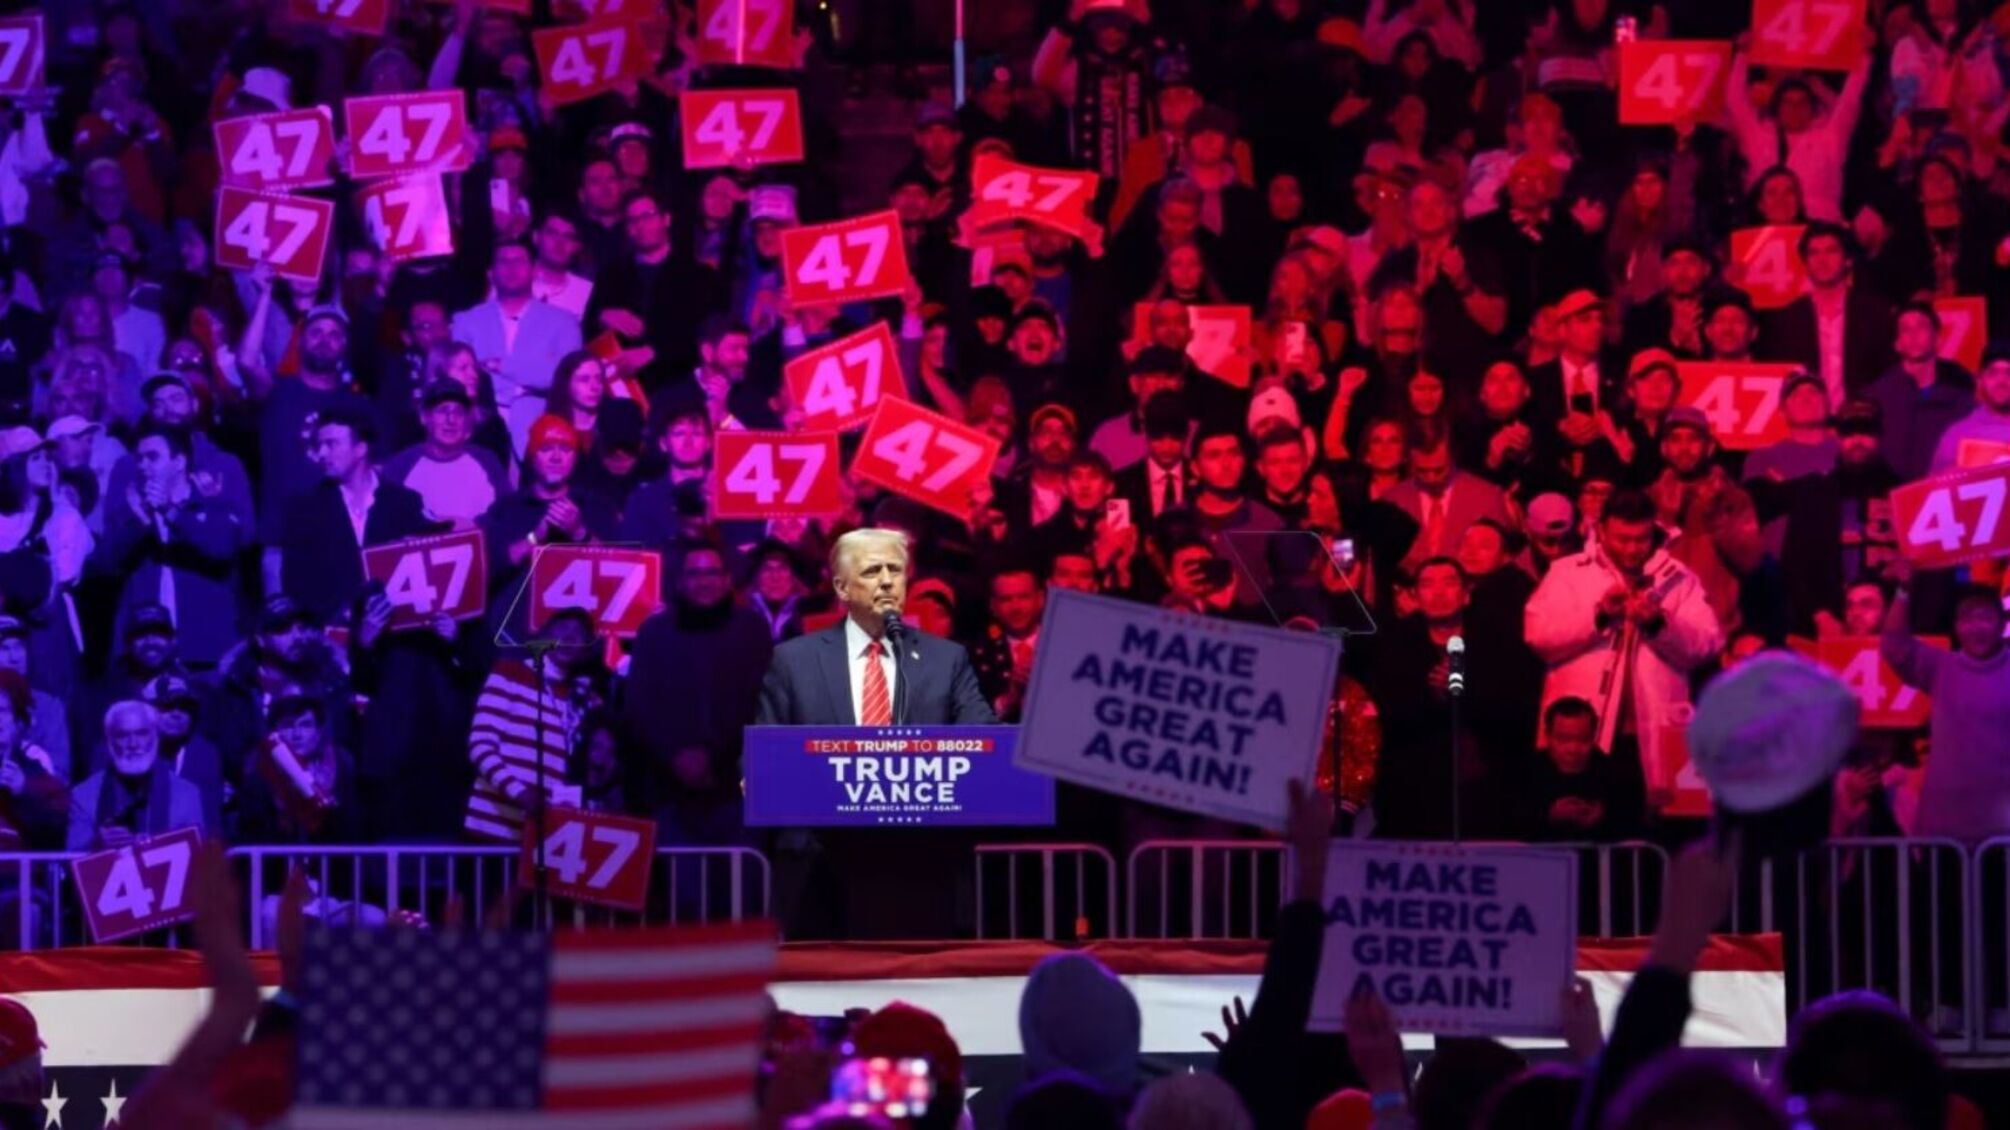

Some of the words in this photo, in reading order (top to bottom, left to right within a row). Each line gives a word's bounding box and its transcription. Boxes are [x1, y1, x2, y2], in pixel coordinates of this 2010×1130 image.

[0, 28, 30, 80] 7
[551, 27, 626, 86] 47
[1761, 3, 1851, 55] 47
[1634, 53, 1724, 108] 47
[230, 119, 320, 181] 47
[360, 102, 452, 163] 47
[695, 100, 785, 155] 47
[982, 171, 1084, 212] 47
[224, 202, 318, 264] 47
[797, 225, 890, 290] 47
[1745, 239, 1794, 293] 4
[1938, 310, 1972, 360] 7
[804, 338, 884, 417] 47
[1693, 375, 1784, 435] 47
[725, 443, 827, 504] 47
[873, 420, 984, 492] 47
[1908, 476, 2007, 551] 47
[385, 543, 475, 618] 47
[542, 559, 647, 621] 47
[1121, 624, 1259, 680] MAKE
[1071, 654, 1288, 726] AMERICA
[812, 740, 850, 753] TEXT
[855, 740, 908, 752] TRUMP
[912, 740, 933, 753] TO
[936, 740, 983, 752] 88022
[1093, 699, 1255, 756] GREAT
[828, 756, 971, 782] TRUMP
[845, 782, 955, 803] VANCE
[1082, 731, 1253, 796] AGAIN!
[98, 840, 192, 921] 47
[533, 821, 640, 890] 47
[1365, 859, 1498, 895] MAKE
[1325, 896, 1538, 936] AMERICA
[1352, 934, 1509, 971] GREAT
[1351, 972, 1514, 1010] AGAIN!
